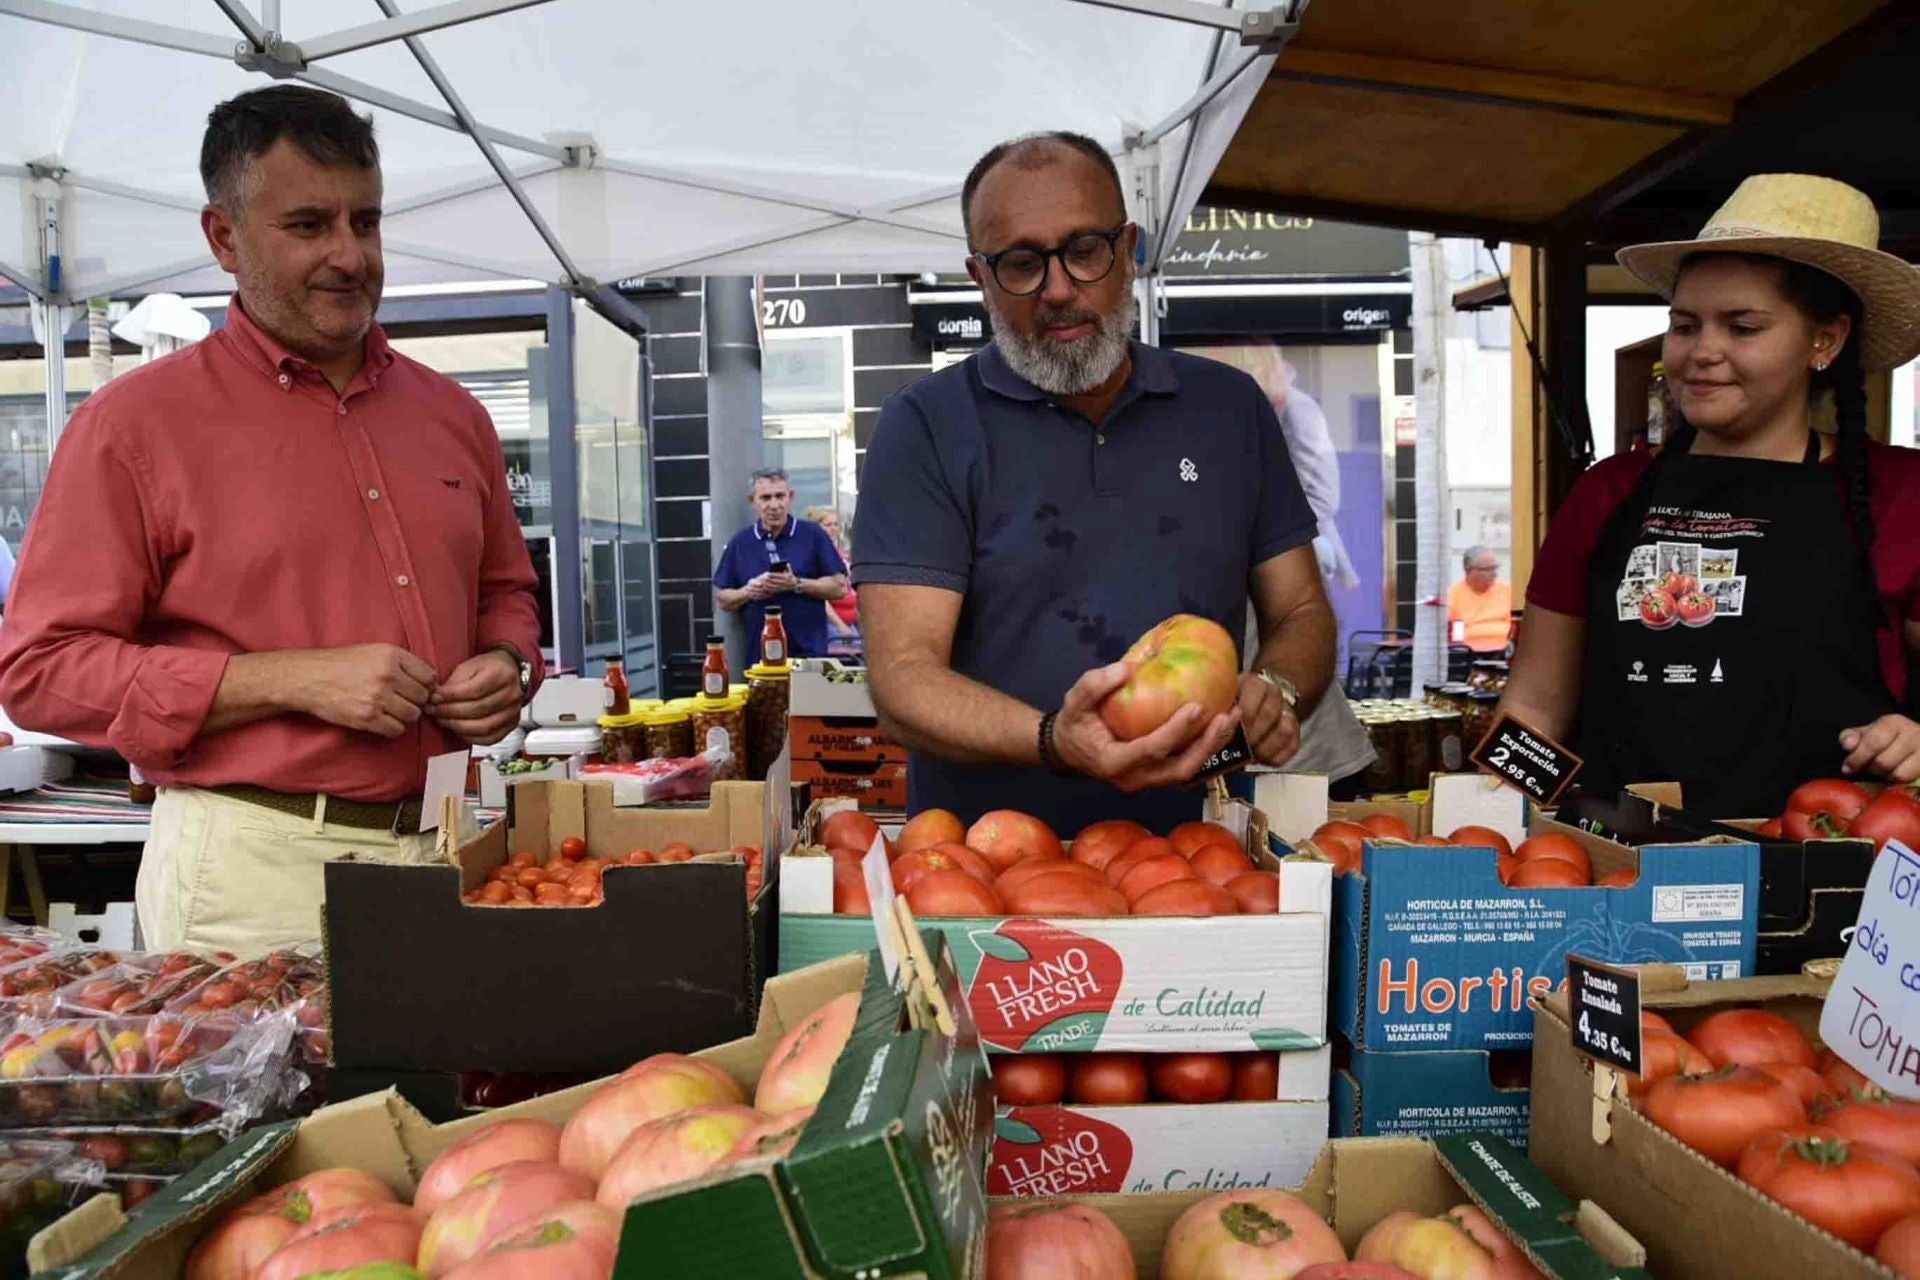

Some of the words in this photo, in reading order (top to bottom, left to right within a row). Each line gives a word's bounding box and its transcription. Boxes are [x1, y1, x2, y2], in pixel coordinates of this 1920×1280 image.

[1182, 206, 1314, 232] LINICS
[763, 298, 806, 326] 270
[938, 315, 982, 334] dorsia
[1342, 307, 1391, 325] origen
[1500, 733, 1560, 777] Exportación
[1519, 731, 1556, 760] Tomate
[1488, 747, 1526, 780] 2.95
[1407, 899, 1457, 911] HORTICOLA
[1460, 899, 1473, 910] DE
[1529, 897, 1547, 909] S.L.
[1410, 934, 1457, 944] MAZARRON
[1464, 932, 1496, 943] MURCIA
[1503, 930, 1535, 942] ESPAÑA
[986, 948, 1089, 1004] LLANO
[1583, 970, 1618, 995] Tomate
[997, 970, 1101, 1028] FRESH
[1122, 997, 1145, 1016] de
[1156, 986, 1266, 1020] Calidad
[1581, 988, 1622, 1015] Ensalada
[1036, 1020, 1095, 1050] TRADE
[1384, 1023, 1435, 1033] TOMATES
[1437, 1023, 1453, 1033] DE
[1387, 1031, 1448, 1042] MAZARRON
[1578, 1010, 1608, 1050] 4.35
[1398, 1107, 1451, 1118] HORTICOLA
[1452, 1107, 1465, 1117] DE
[1000, 1131, 1099, 1187] LLANO
[1009, 1153, 1111, 1195] FRESH
[1133, 1178, 1154, 1192] de
[1164, 1168, 1273, 1191] Calidad
